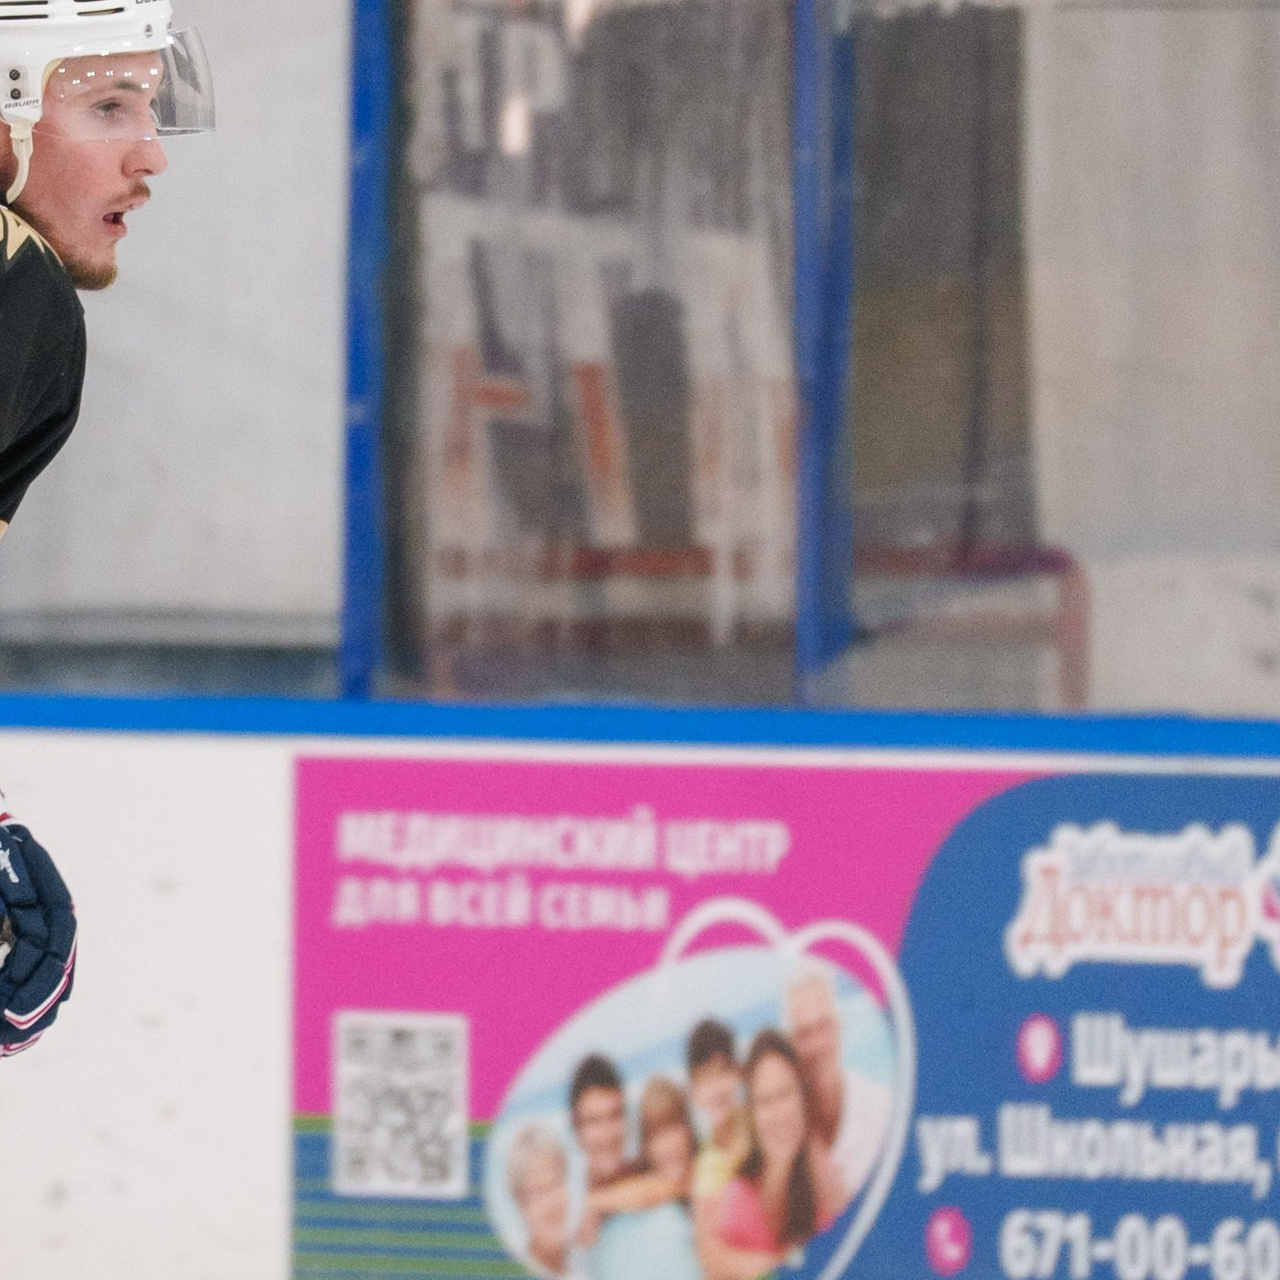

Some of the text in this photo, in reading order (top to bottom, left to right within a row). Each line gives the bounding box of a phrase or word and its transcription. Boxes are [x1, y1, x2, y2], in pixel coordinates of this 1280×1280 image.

[337, 804, 791, 879] МЕДИЦИНСКИЙ ЦЕНТР
[332, 874, 671, 932] ДЛЯ ВСЕЙ СЕМЬИ
[1018, 863, 1250, 970] Доктор
[917, 1104, 1270, 1199] ул. Школьная,
